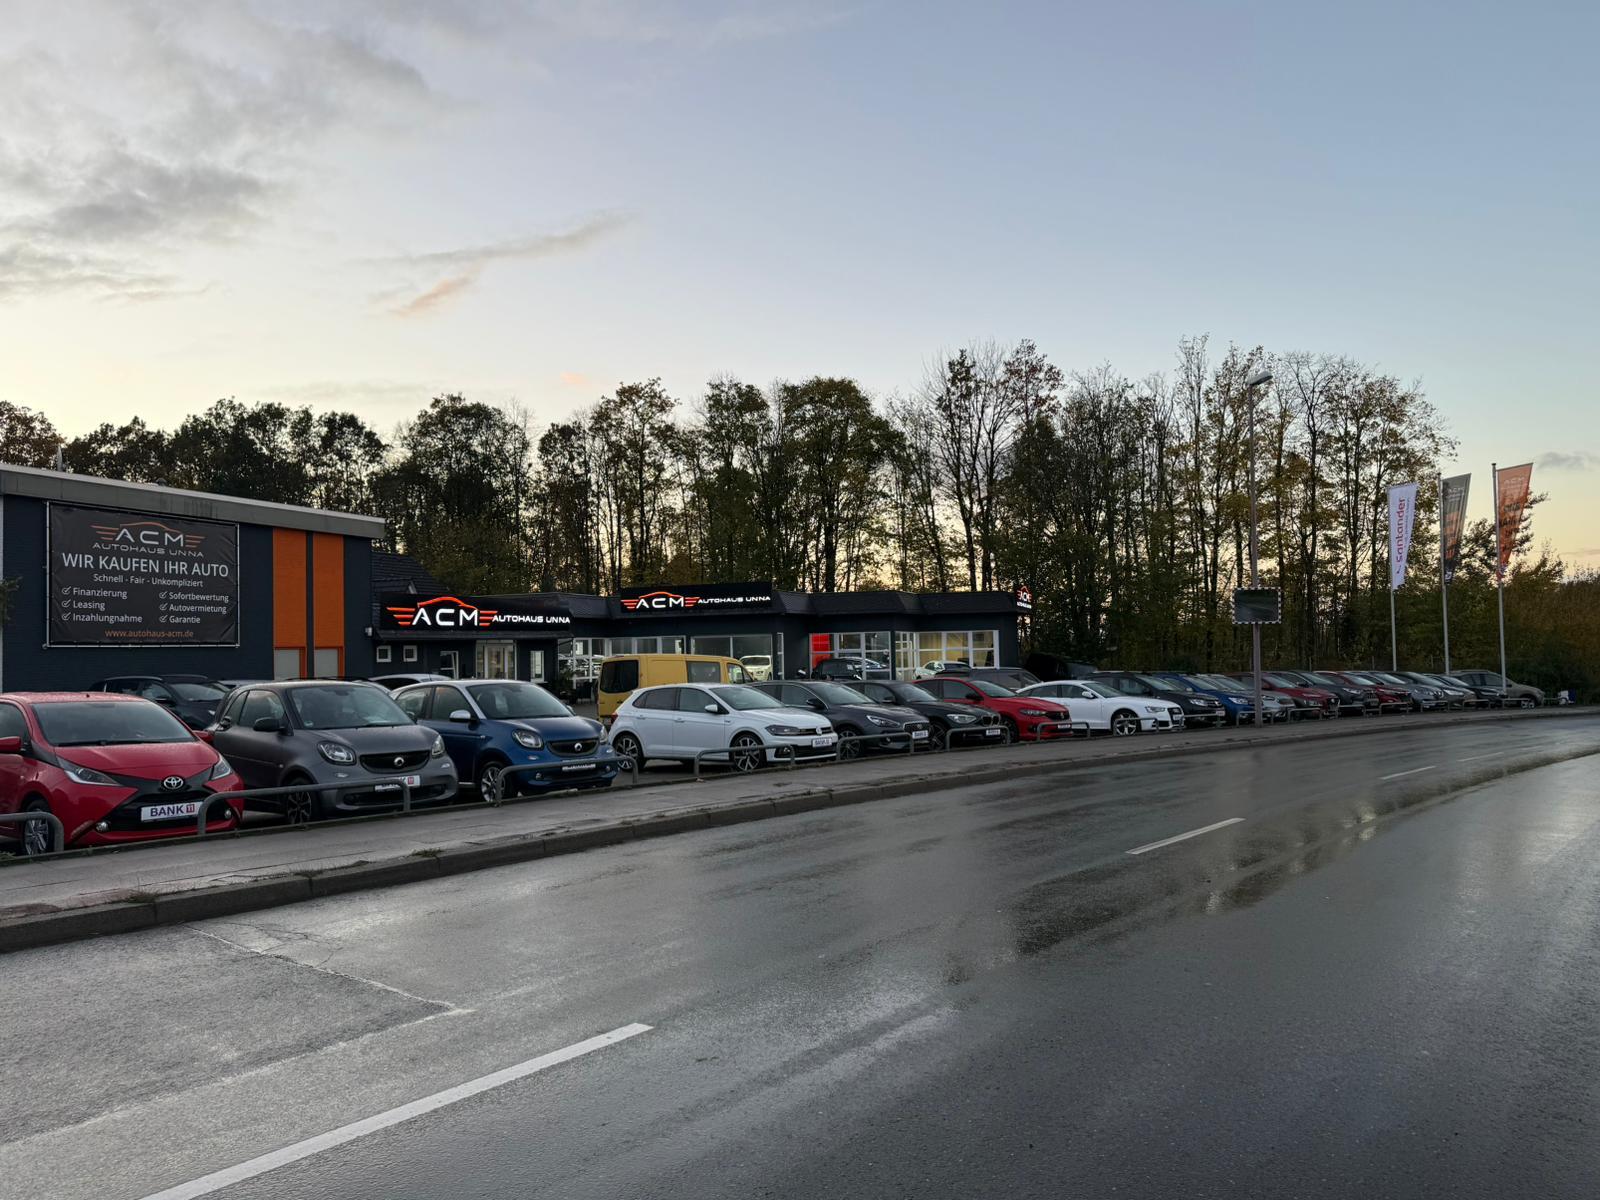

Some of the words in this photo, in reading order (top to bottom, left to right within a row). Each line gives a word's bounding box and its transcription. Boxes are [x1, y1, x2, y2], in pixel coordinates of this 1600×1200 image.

[1396, 499, 1405, 563] Santander
[115, 528, 184, 547] ACM
[92, 542, 165, 555] AUTOHAUS
[169, 548, 204, 558] UNNA
[62, 552, 94, 569] WIR
[99, 555, 159, 573] KAUFEN
[164, 560, 188, 575] IHR
[191, 562, 229, 577] AUTO
[93, 573, 124, 583] Schnell
[130, 576, 145, 584] Fair
[152, 577, 203, 588] Unkompliziert
[73, 587, 128, 600] Finanzierung
[169, 592, 229, 603] Sofortbewertung
[73, 600, 106, 612] Leasing
[169, 603, 228, 615] Autovermietung
[636, 597, 684, 609] ACM
[73, 613, 143, 624] Inzahlungnahme
[169, 615, 201, 624] Garantie
[412, 607, 478, 626] ACM
[491, 614, 544, 623] AUTOHAUS
[545, 615, 571, 624] UNNA
[150, 805, 184, 817] BANK
